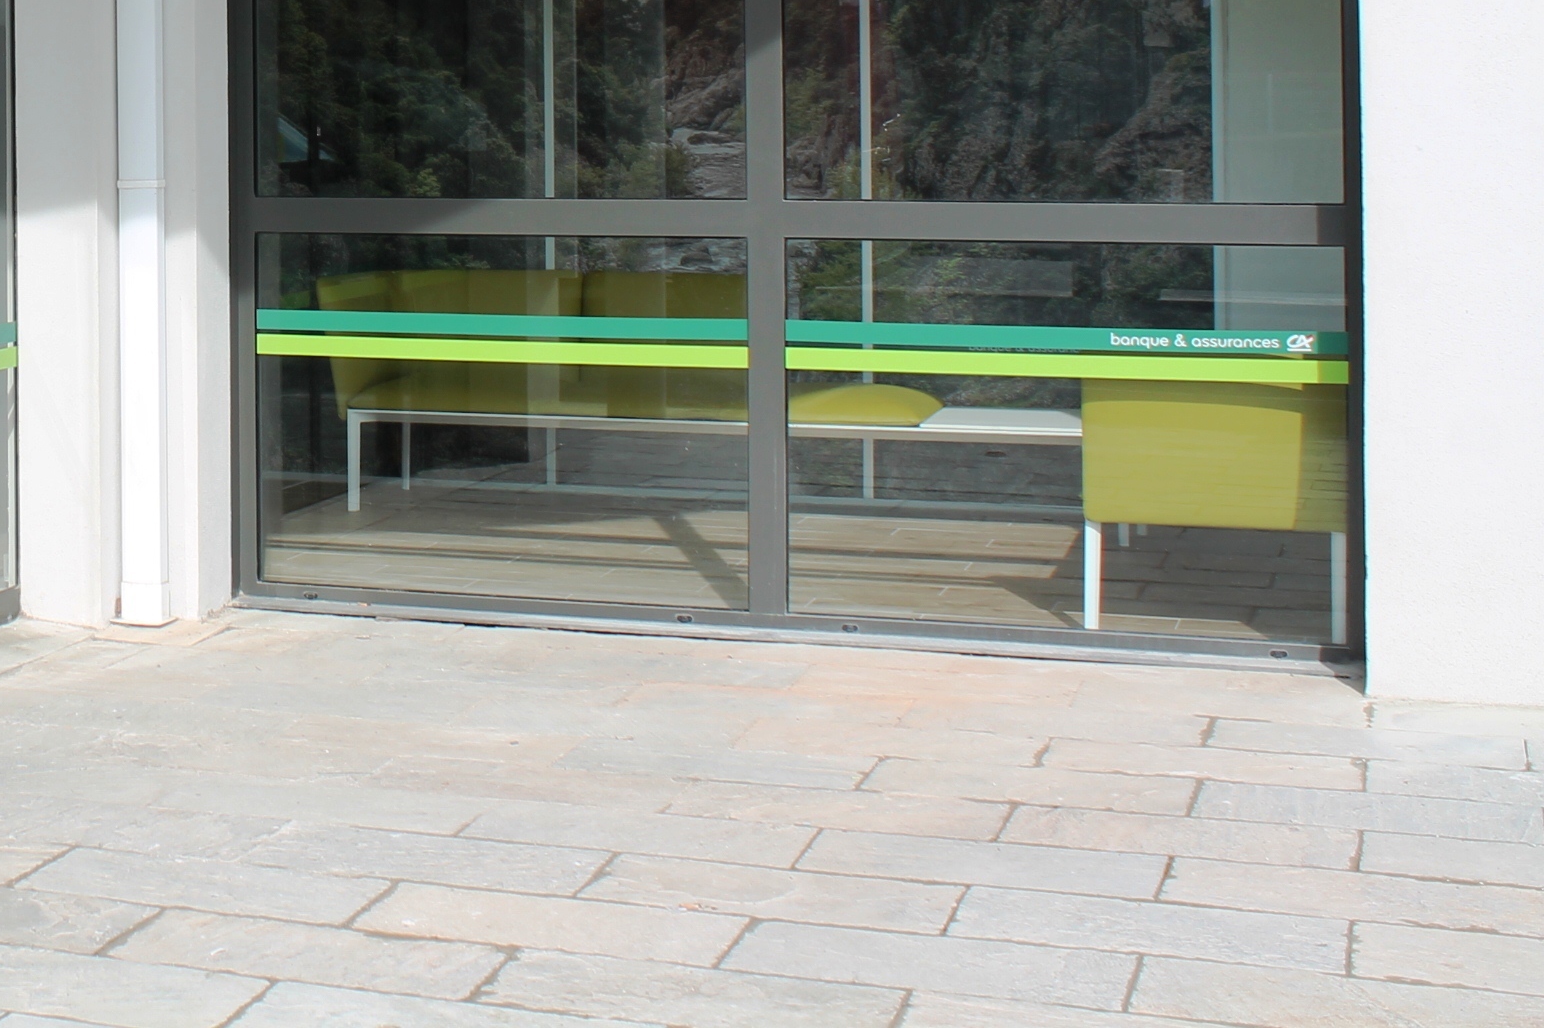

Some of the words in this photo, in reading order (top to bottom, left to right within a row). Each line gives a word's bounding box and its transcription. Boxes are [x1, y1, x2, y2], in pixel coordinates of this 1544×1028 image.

[1110, 332, 1170, 350] banque
[1174, 333, 1187, 348] &
[1191, 336, 1281, 349] assurances
